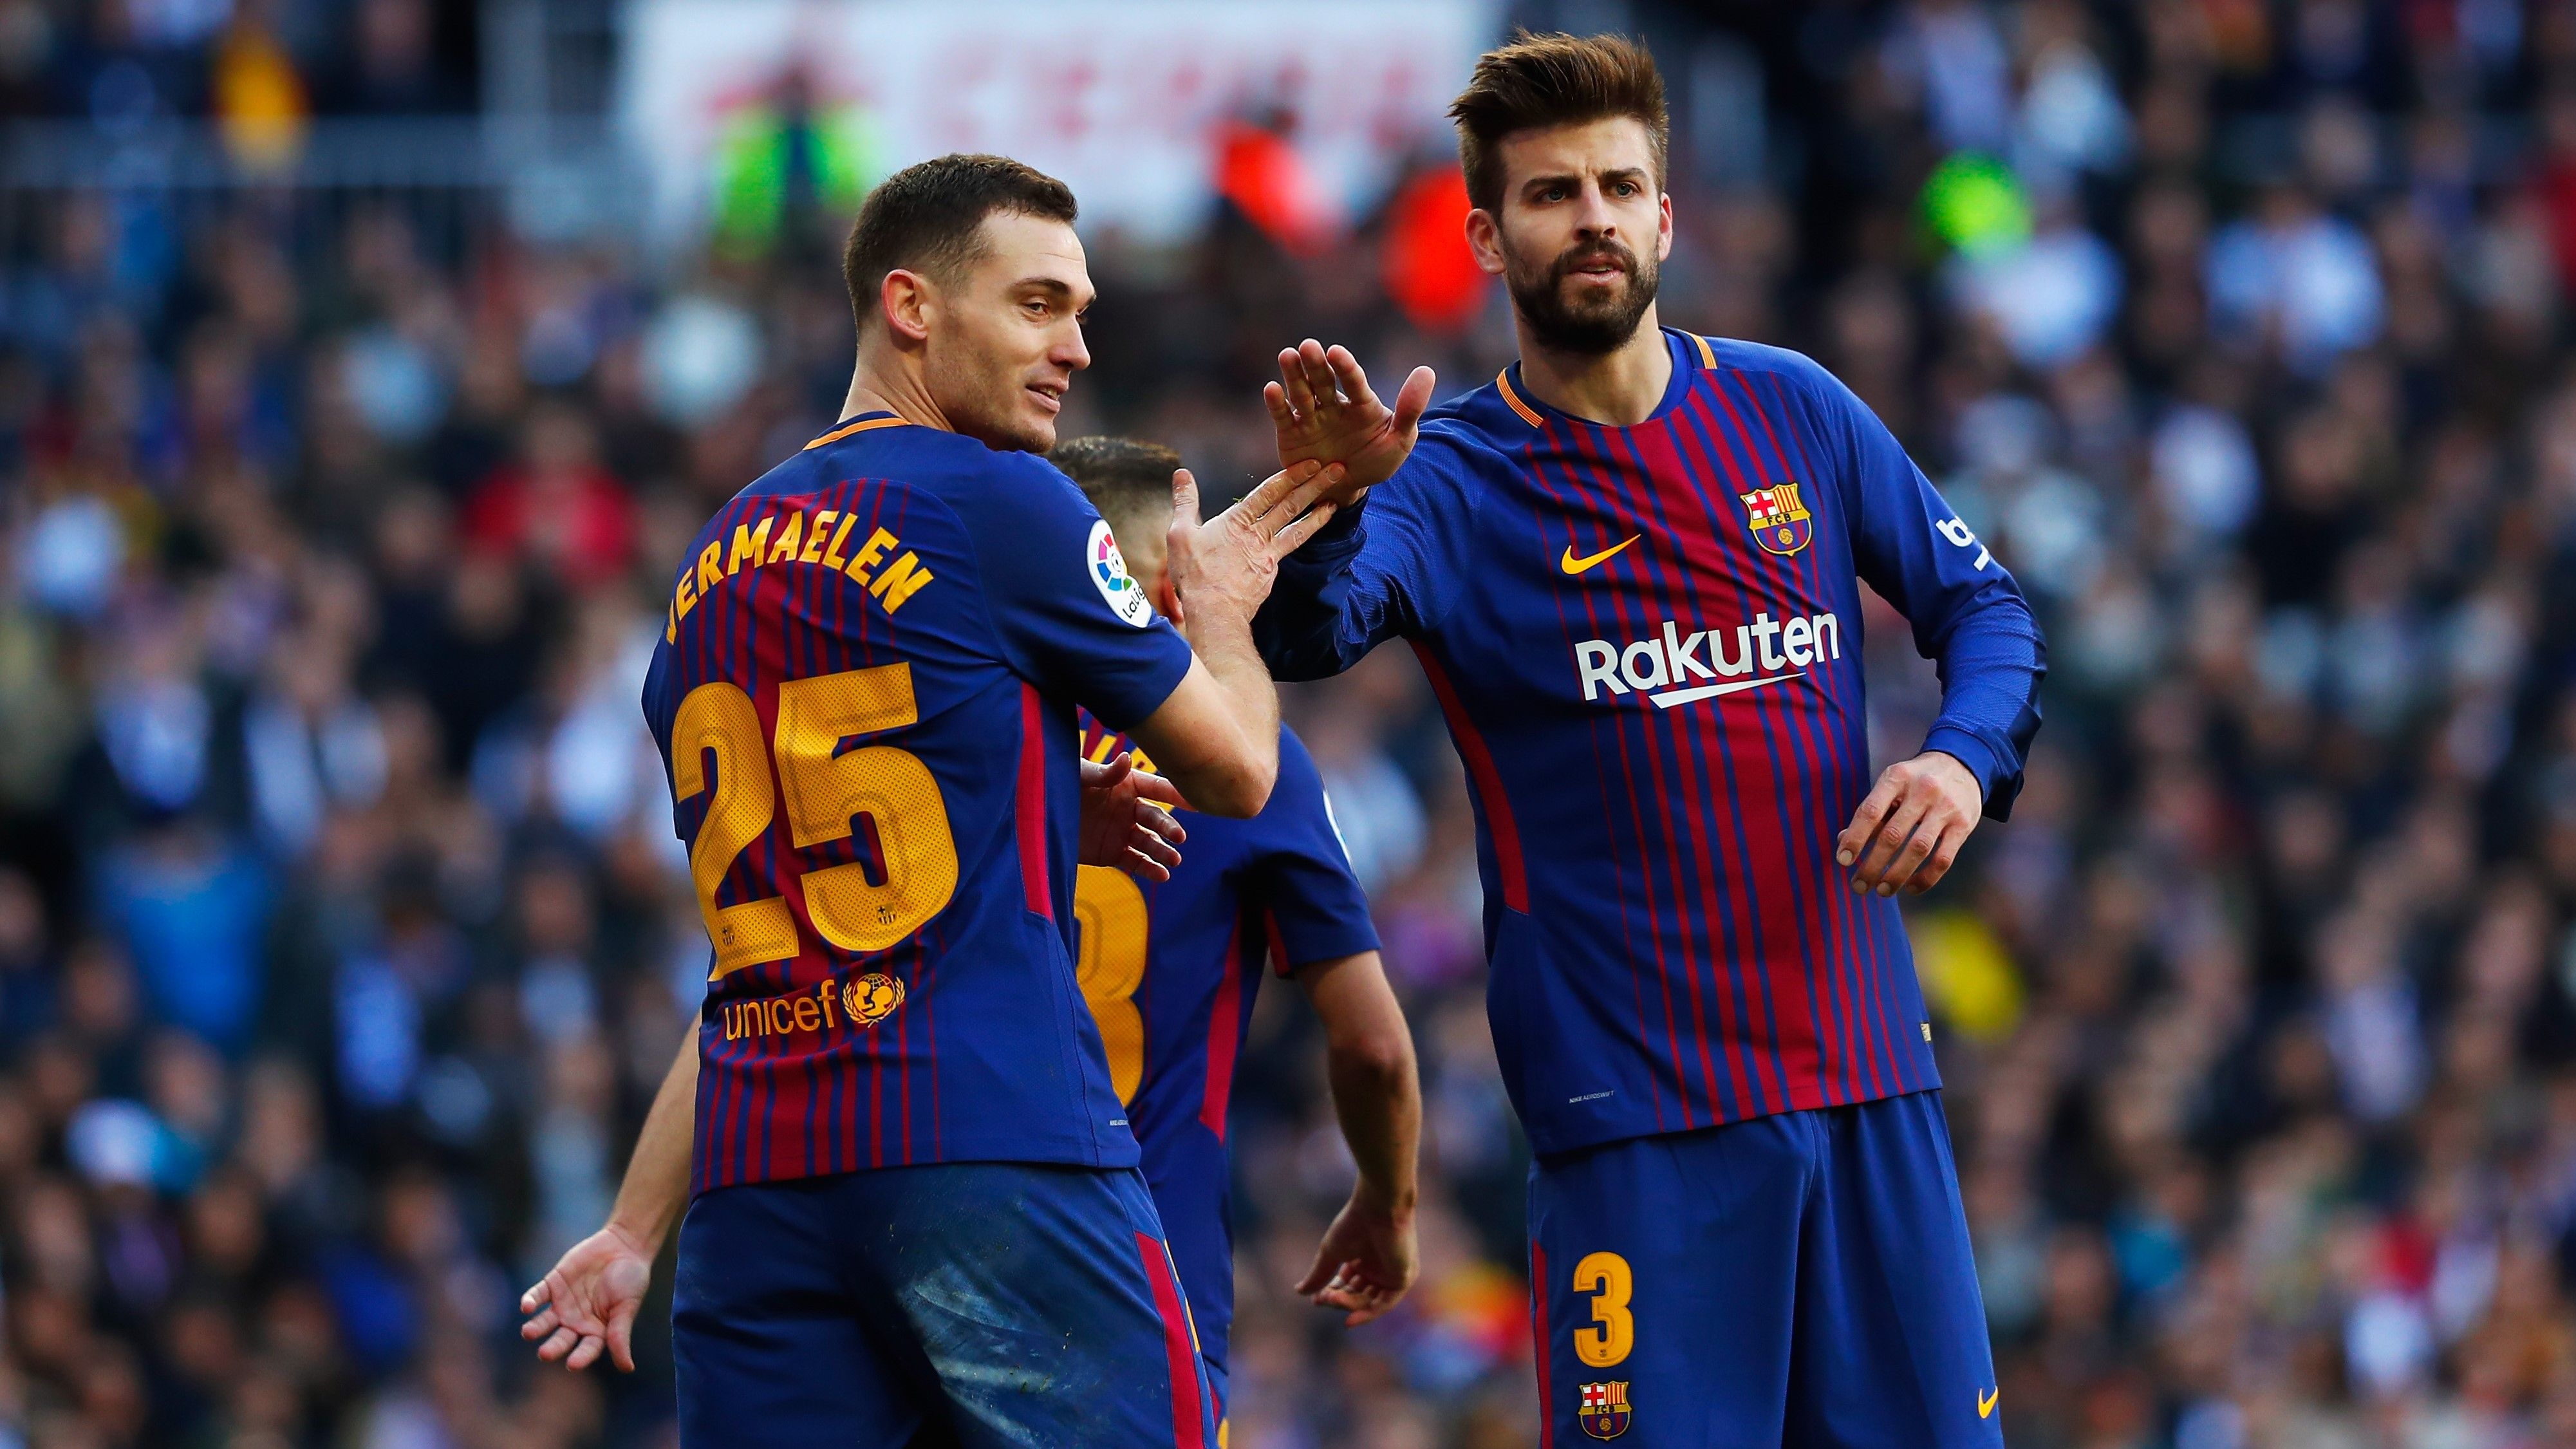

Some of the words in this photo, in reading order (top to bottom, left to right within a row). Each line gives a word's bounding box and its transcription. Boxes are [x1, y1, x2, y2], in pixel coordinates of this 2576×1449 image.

[1767, 513, 1791, 526] FCB
[1123, 585, 1145, 619] LaLig
[1575, 612, 1840, 701] Rakuten
[672, 662, 958, 982] 25
[725, 979, 835, 1041] unicef
[1573, 1251, 1634, 1368] 3
